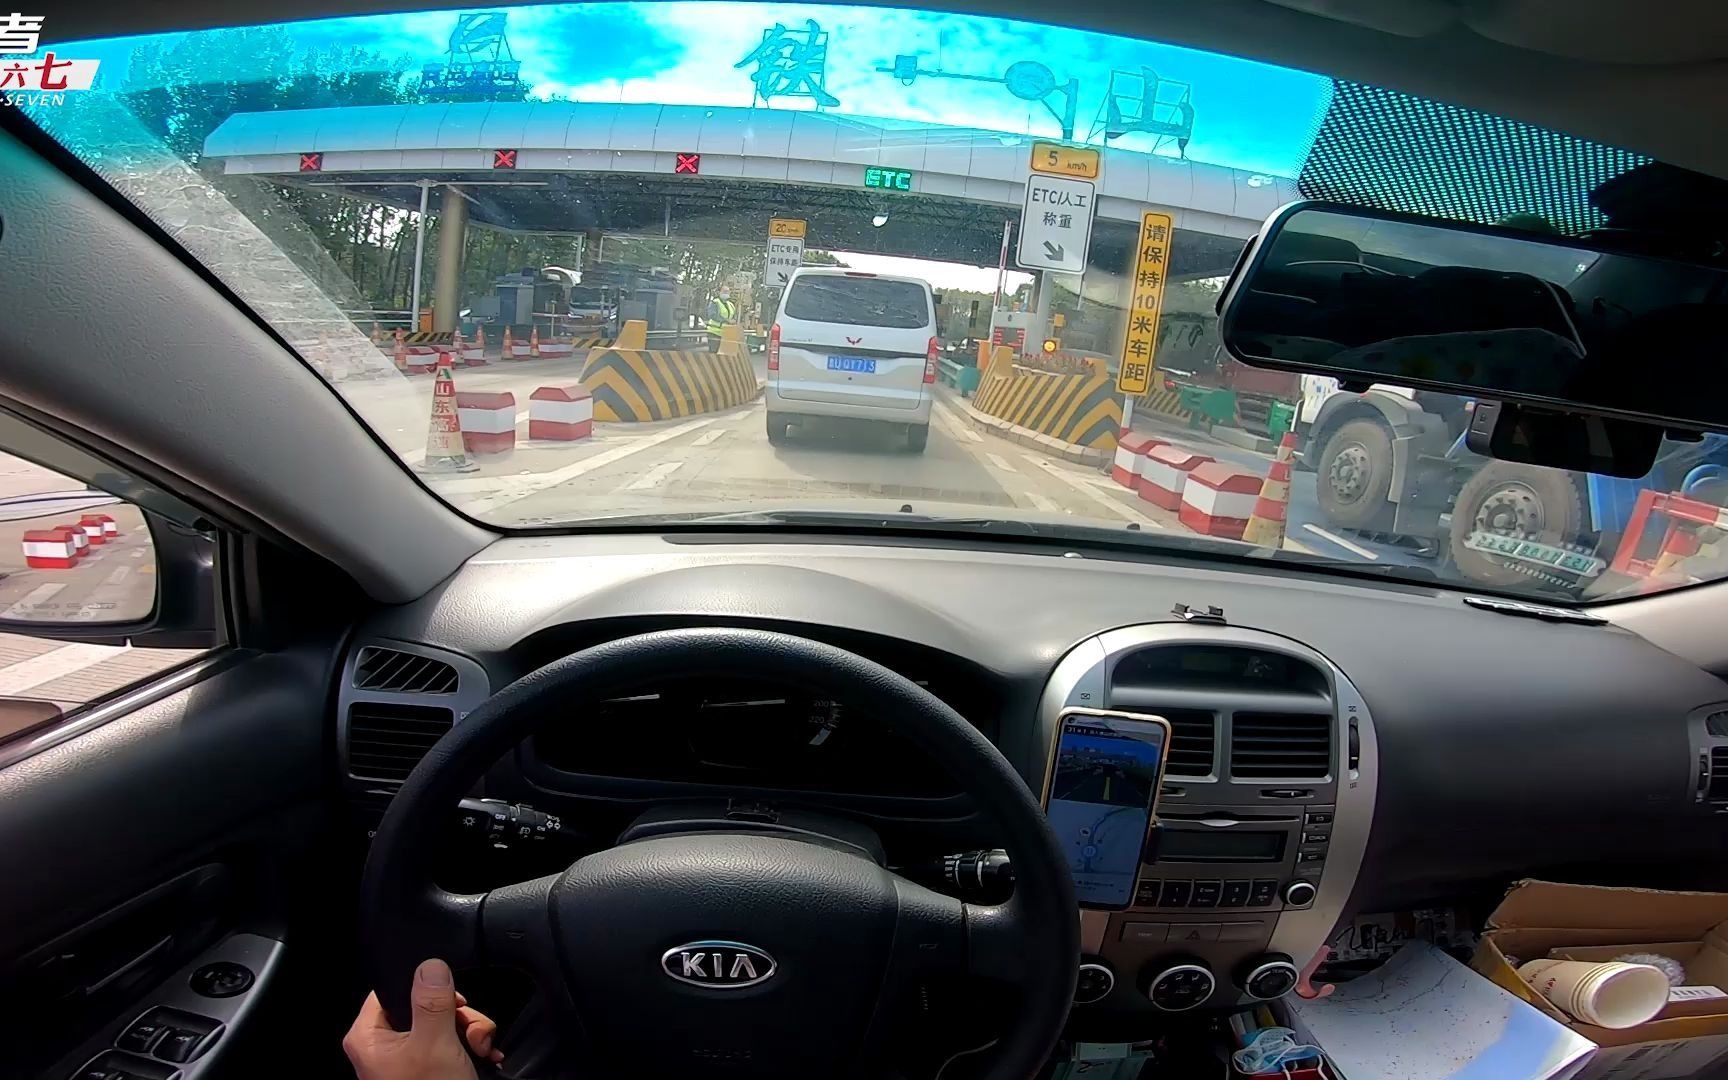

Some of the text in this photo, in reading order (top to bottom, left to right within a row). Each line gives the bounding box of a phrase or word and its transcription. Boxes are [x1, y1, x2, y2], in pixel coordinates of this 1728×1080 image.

[1048, 150, 1058, 166] 5
[865, 169, 910, 189] ETC
[1032, 187, 1087, 208] ETC/人工
[1042, 211, 1072, 229] 称重
[1124, 224, 1166, 382] 请保持10米车距
[681, 952, 757, 978] KIA
